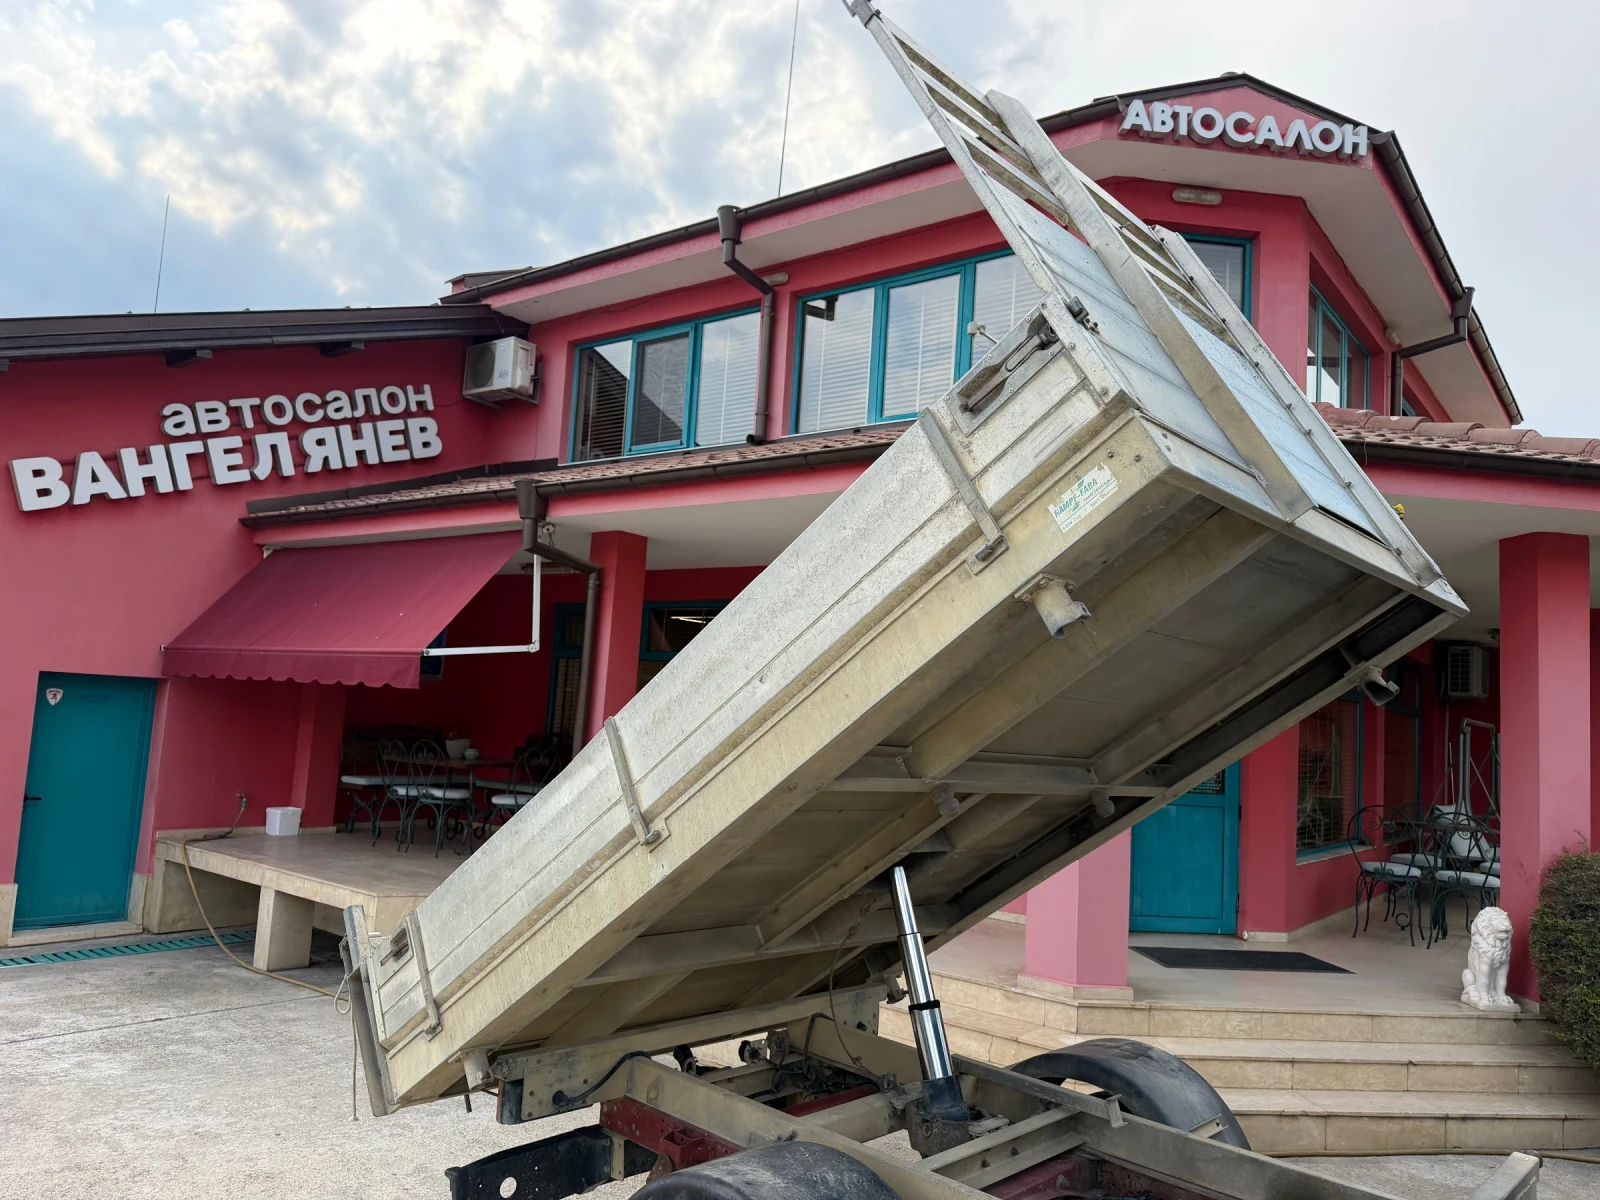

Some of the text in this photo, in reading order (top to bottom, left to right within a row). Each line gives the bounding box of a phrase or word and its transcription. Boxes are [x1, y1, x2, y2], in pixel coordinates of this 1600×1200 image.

[1118, 99, 1368, 160] АВТОСАЛОН
[160, 384, 435, 437] автосалон
[9, 417, 443, 512] ВАНГЕЛ ЯНЕВ
